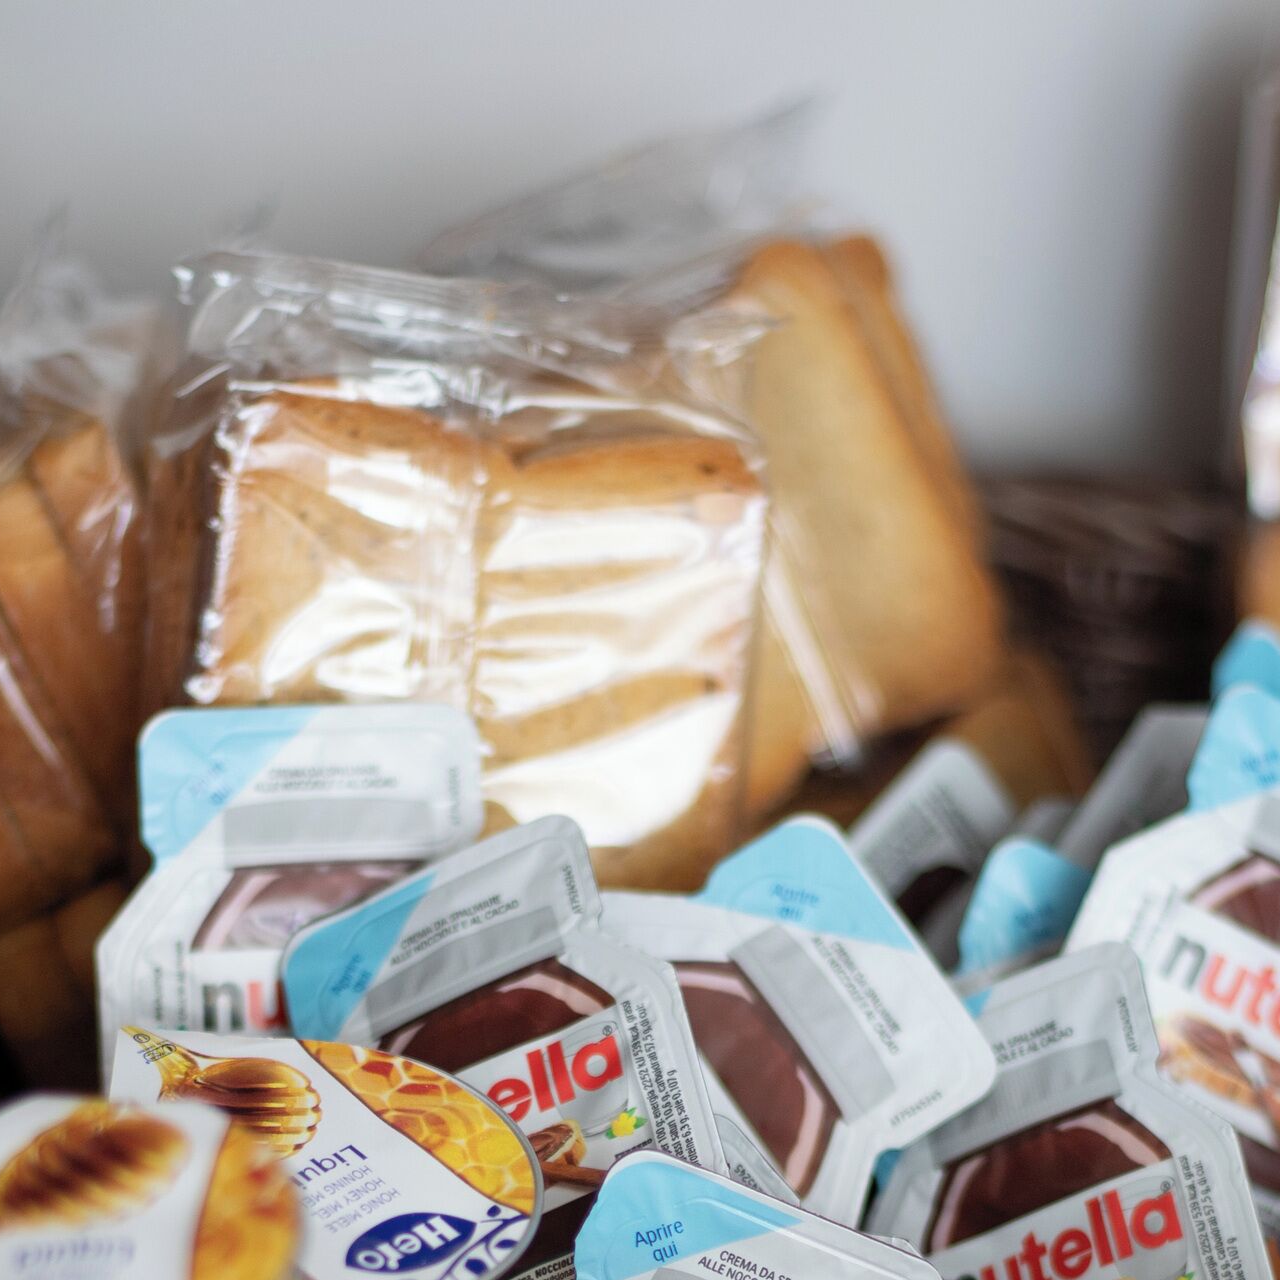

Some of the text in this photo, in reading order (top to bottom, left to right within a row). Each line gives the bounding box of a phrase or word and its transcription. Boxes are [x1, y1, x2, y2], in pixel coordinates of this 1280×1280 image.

[486, 1035, 624, 1123] ella
[638, 1068, 654, 1090] 2252
[647, 1089, 662, 1119] energia
[674, 1099, 686, 1115] sale
[655, 1127, 667, 1143] 100
[679, 1122, 692, 1138] 6,3
[285, 1145, 367, 1194] Liqui
[324, 1165, 370, 1195] HONING
[1179, 1155, 1194, 1181] grassi
[344, 1178, 385, 1202] HONEY
[324, 1188, 397, 1233] HONIG MIELE
[359, 1216, 458, 1269] Hero
[635, 1221, 684, 1248] Aprire
[1198, 1232, 1212, 1256] 2252
[651, 1241, 678, 1262] qui
[720, 1250, 758, 1274] CREMA
[698, 1256, 726, 1275] ALLE
